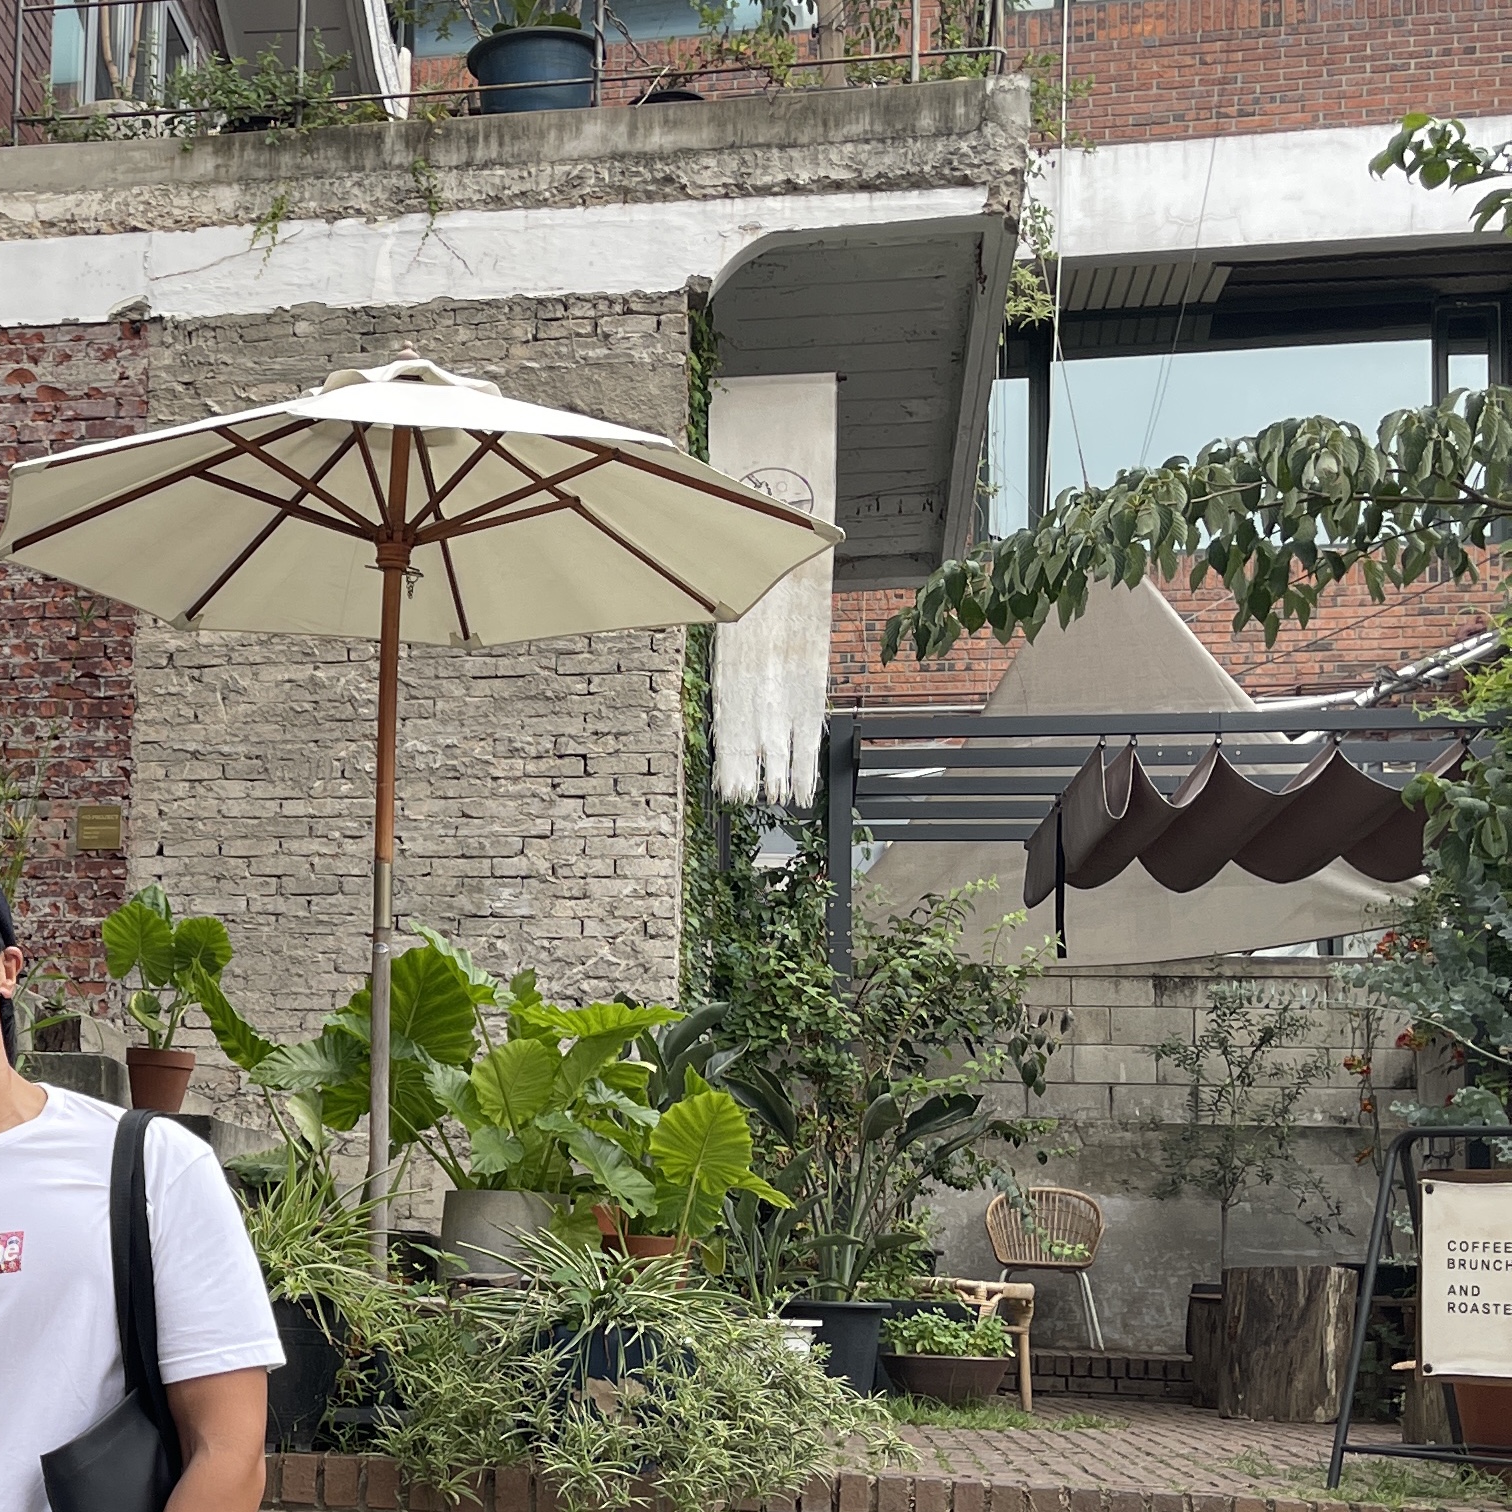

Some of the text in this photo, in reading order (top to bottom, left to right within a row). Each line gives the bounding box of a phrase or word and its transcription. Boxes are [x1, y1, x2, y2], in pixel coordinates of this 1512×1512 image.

[1447, 1240, 1512, 1254] COFFEE
[1447, 1258, 1512, 1271] BRUNCH
[1447, 1285, 1481, 1297] AND
